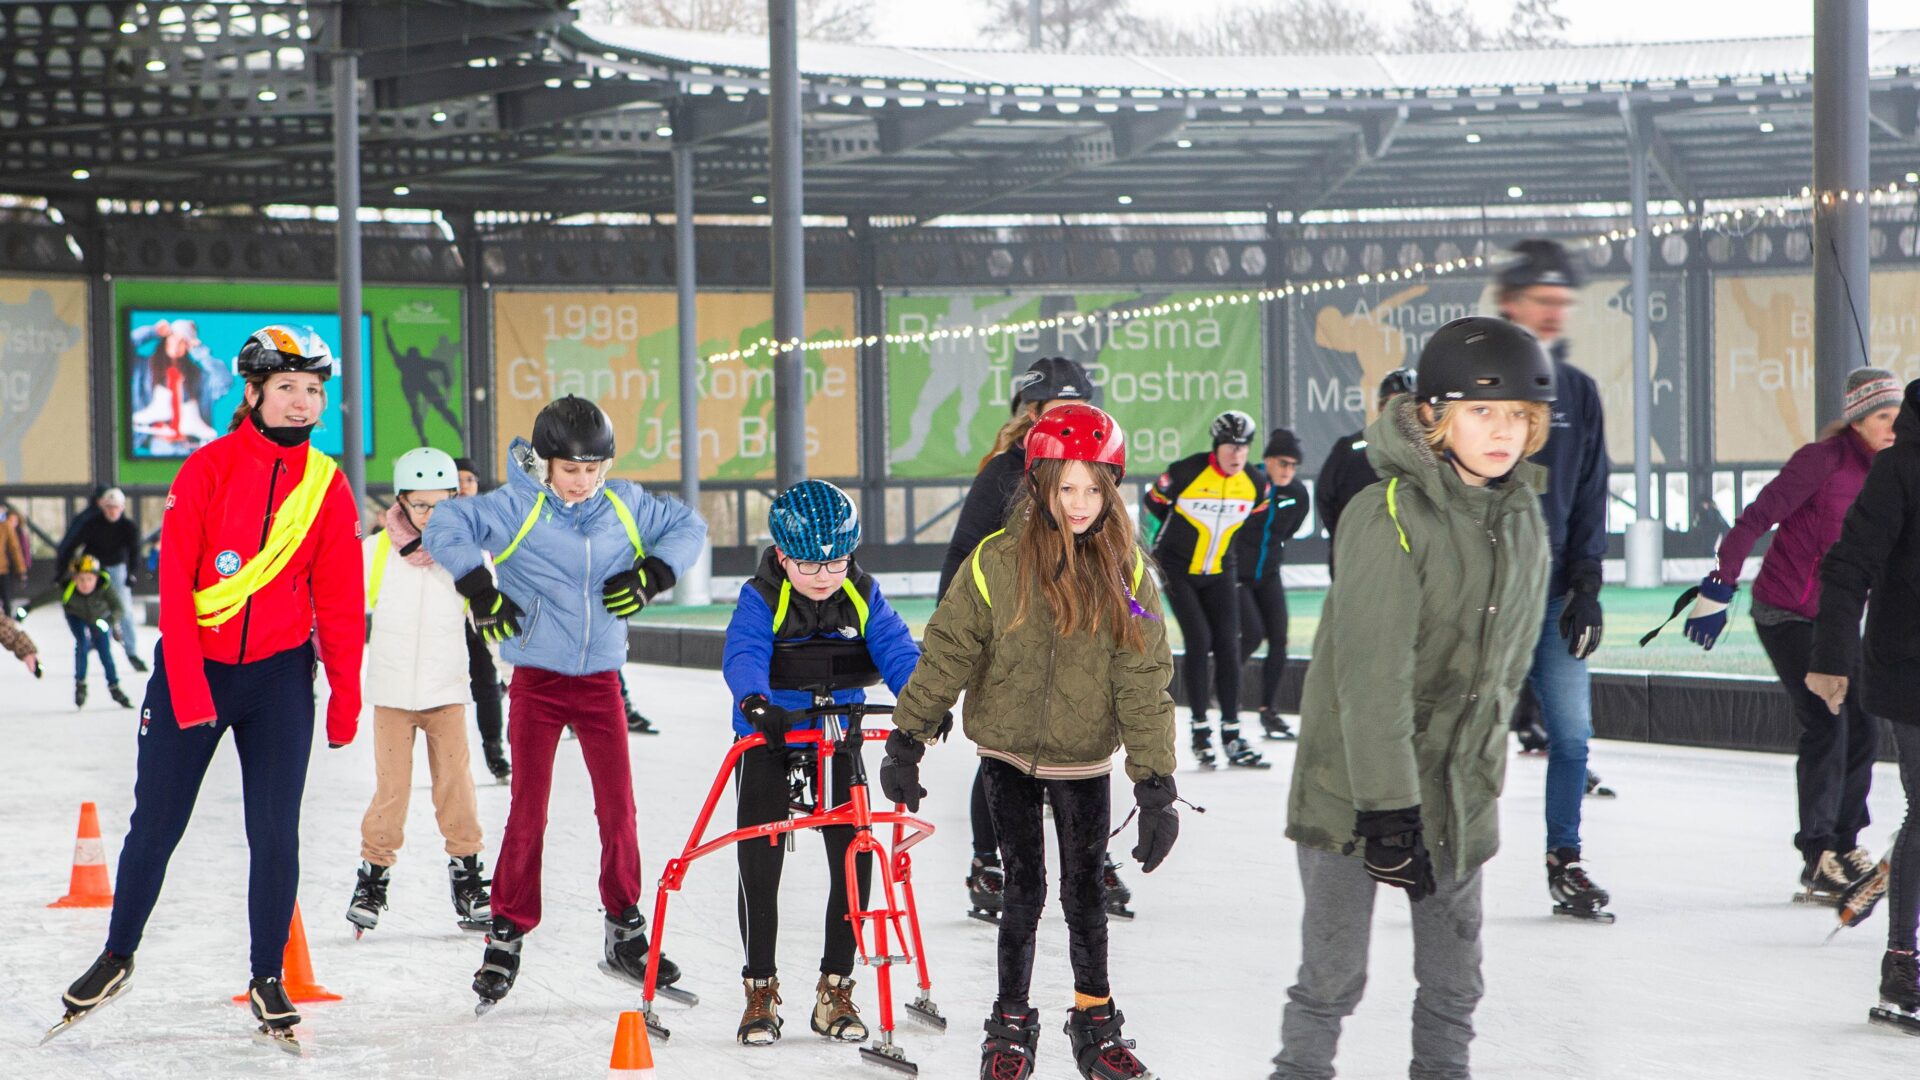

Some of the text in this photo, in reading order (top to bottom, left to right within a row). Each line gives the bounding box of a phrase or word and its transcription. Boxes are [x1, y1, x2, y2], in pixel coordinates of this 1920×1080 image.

[543, 304, 639, 342] 1998
[898, 309, 1222, 363] Rintje Ritsma
[507, 356, 661, 401] Gianni
[738, 415, 821, 459] Bs
[1192, 501, 1235, 513] FACET
[1009, 1043, 1025, 1054] FILA
[1100, 1040, 1114, 1050] FILA
